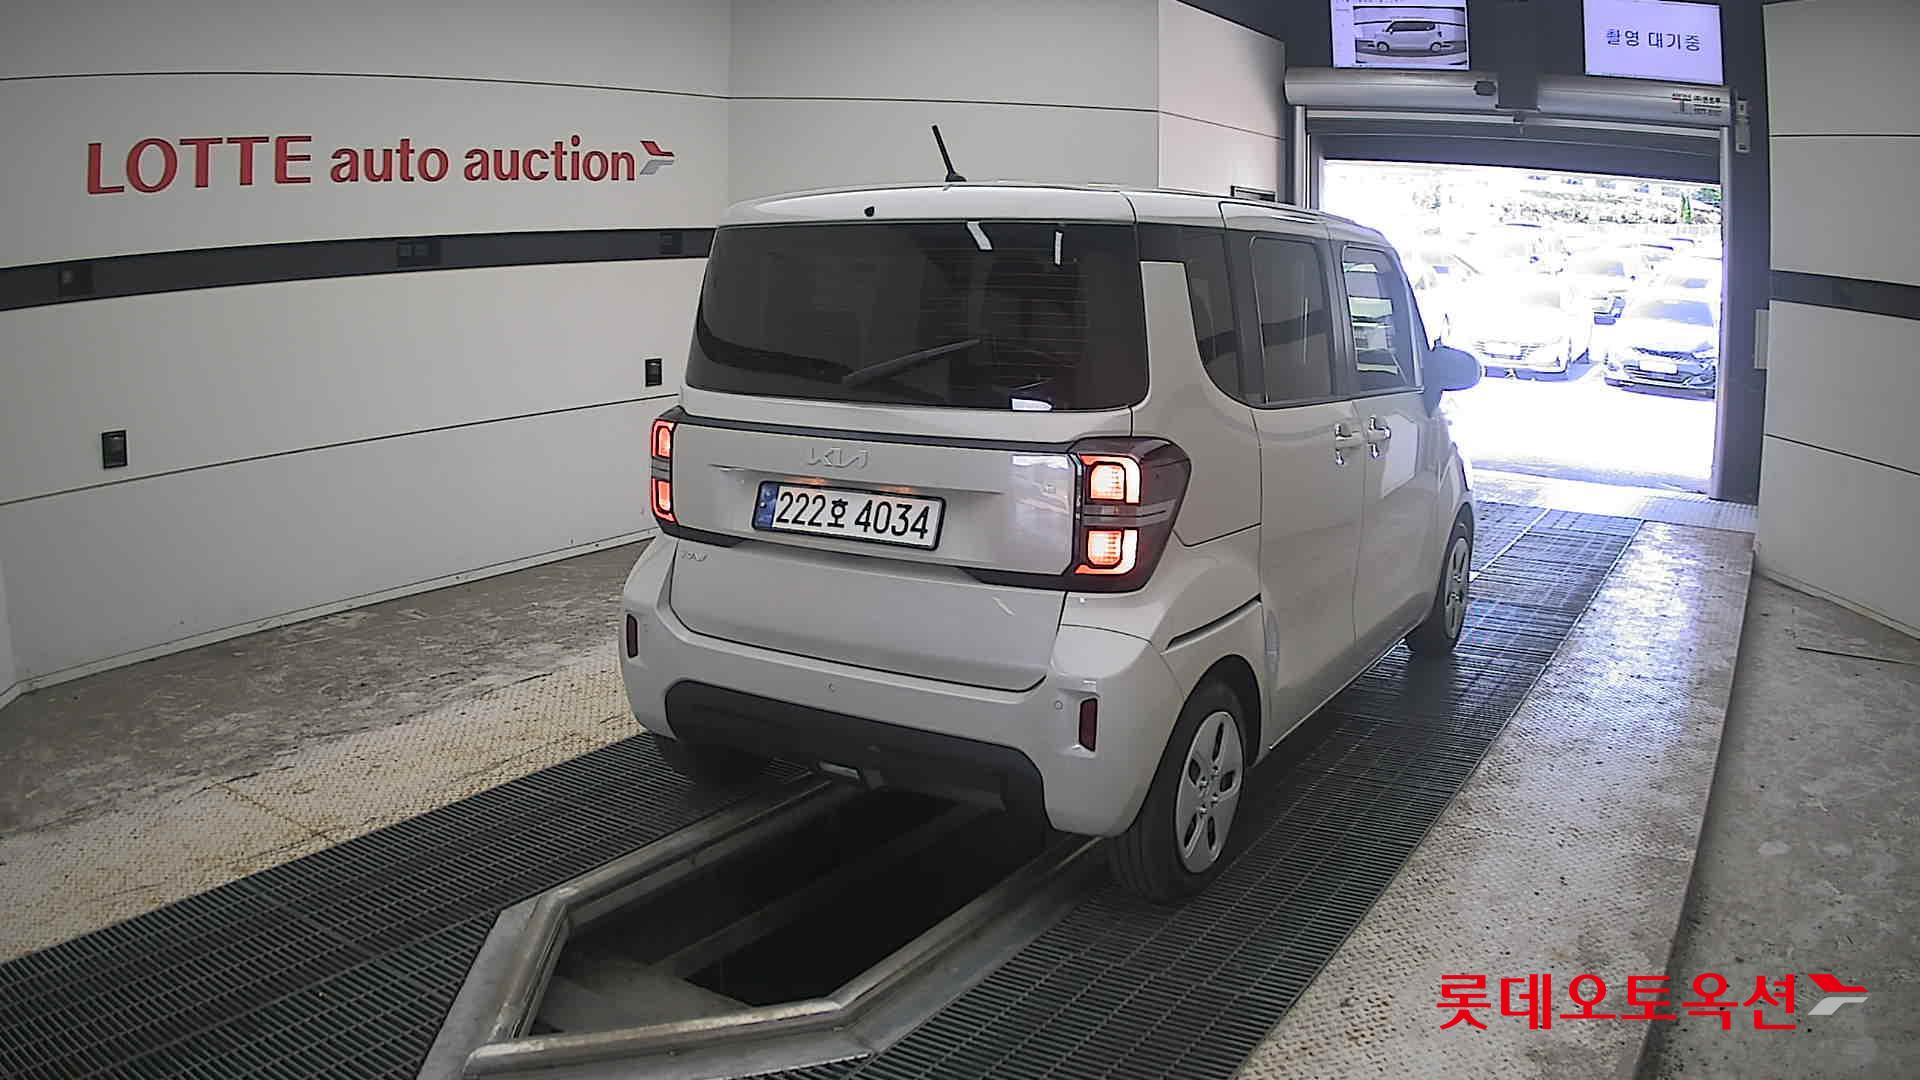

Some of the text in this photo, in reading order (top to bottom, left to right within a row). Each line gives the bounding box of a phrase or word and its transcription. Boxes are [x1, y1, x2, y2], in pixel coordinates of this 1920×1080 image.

[1648, 32, 1701, 52] 대기중
[86, 135, 636, 195] LOTTE auto auction
[775, 490, 931, 540] 222호 4034
